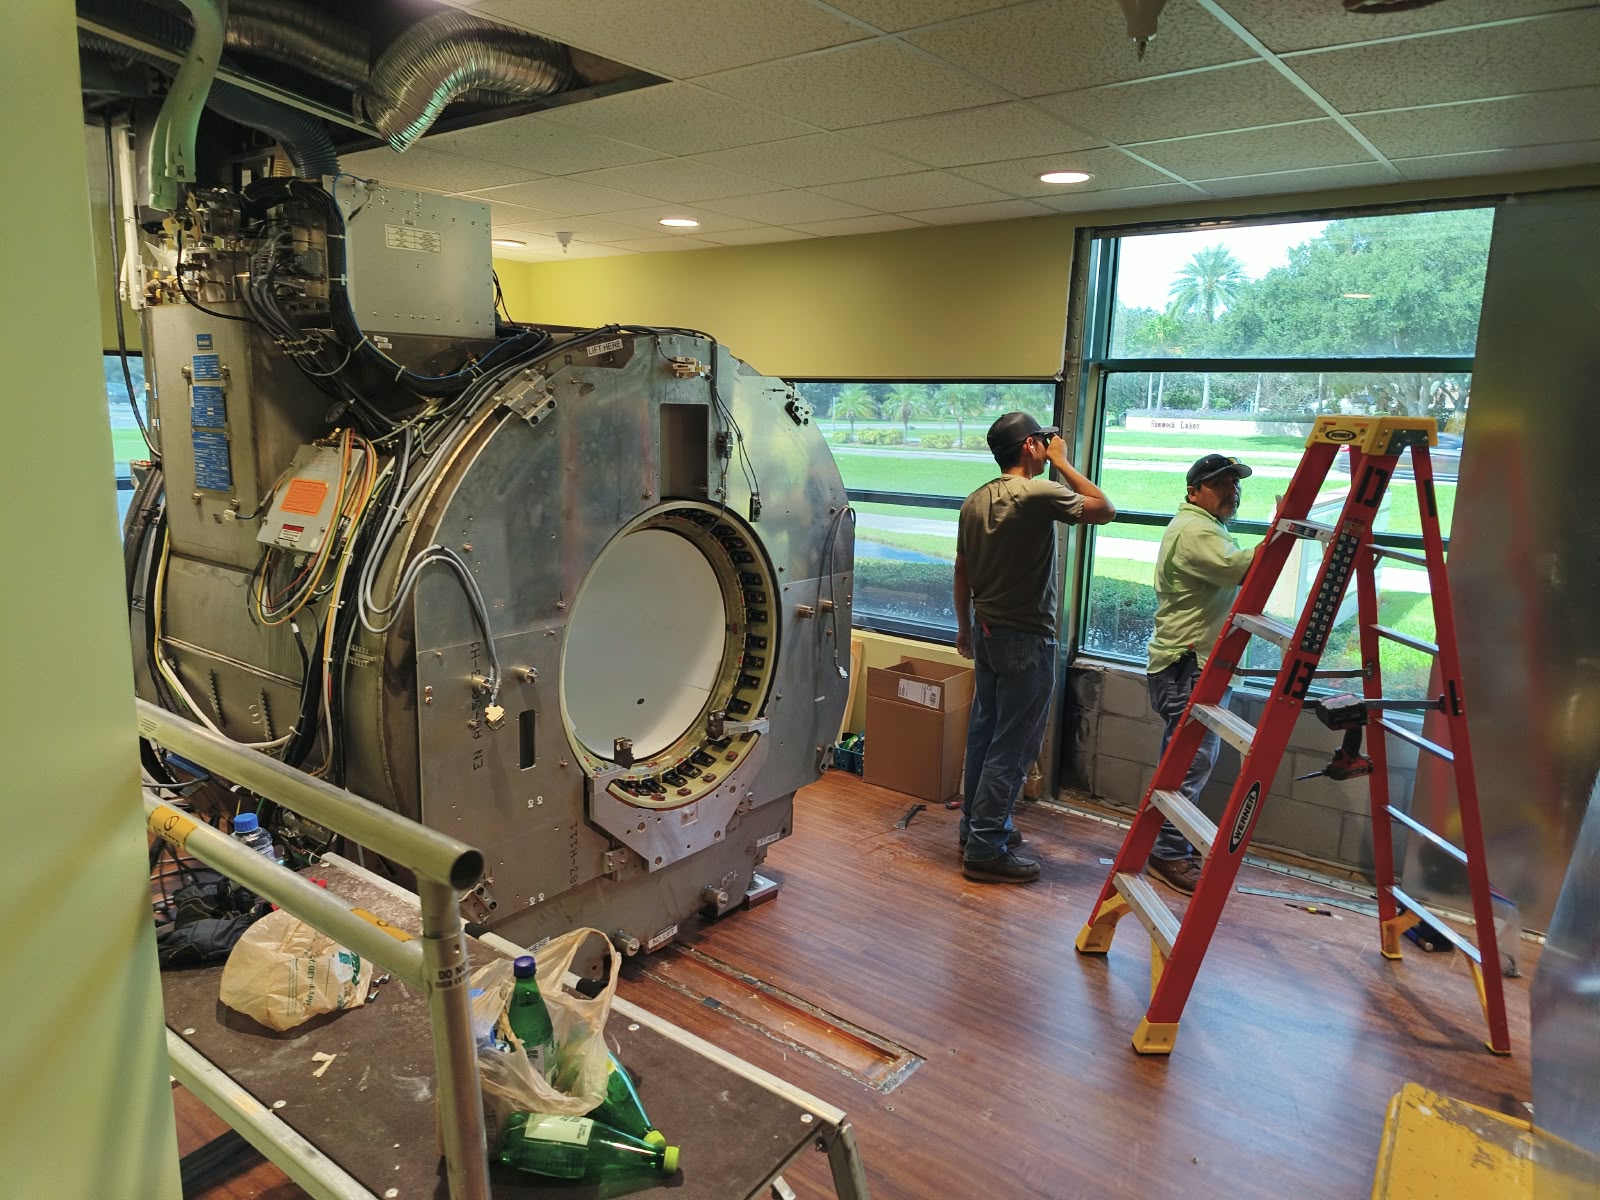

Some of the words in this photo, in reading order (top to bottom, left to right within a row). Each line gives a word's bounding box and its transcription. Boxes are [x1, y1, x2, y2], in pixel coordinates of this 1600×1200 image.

[588, 345, 603, 355] LIFT
[603, 340, 621, 351] HERE
[1180, 420, 1199, 430] Lakes
[1233, 794, 1257, 840] WERNER
[652, 936, 662, 945] NO
[662, 929, 674, 940] LIFT
[438, 969, 453, 980] DO
